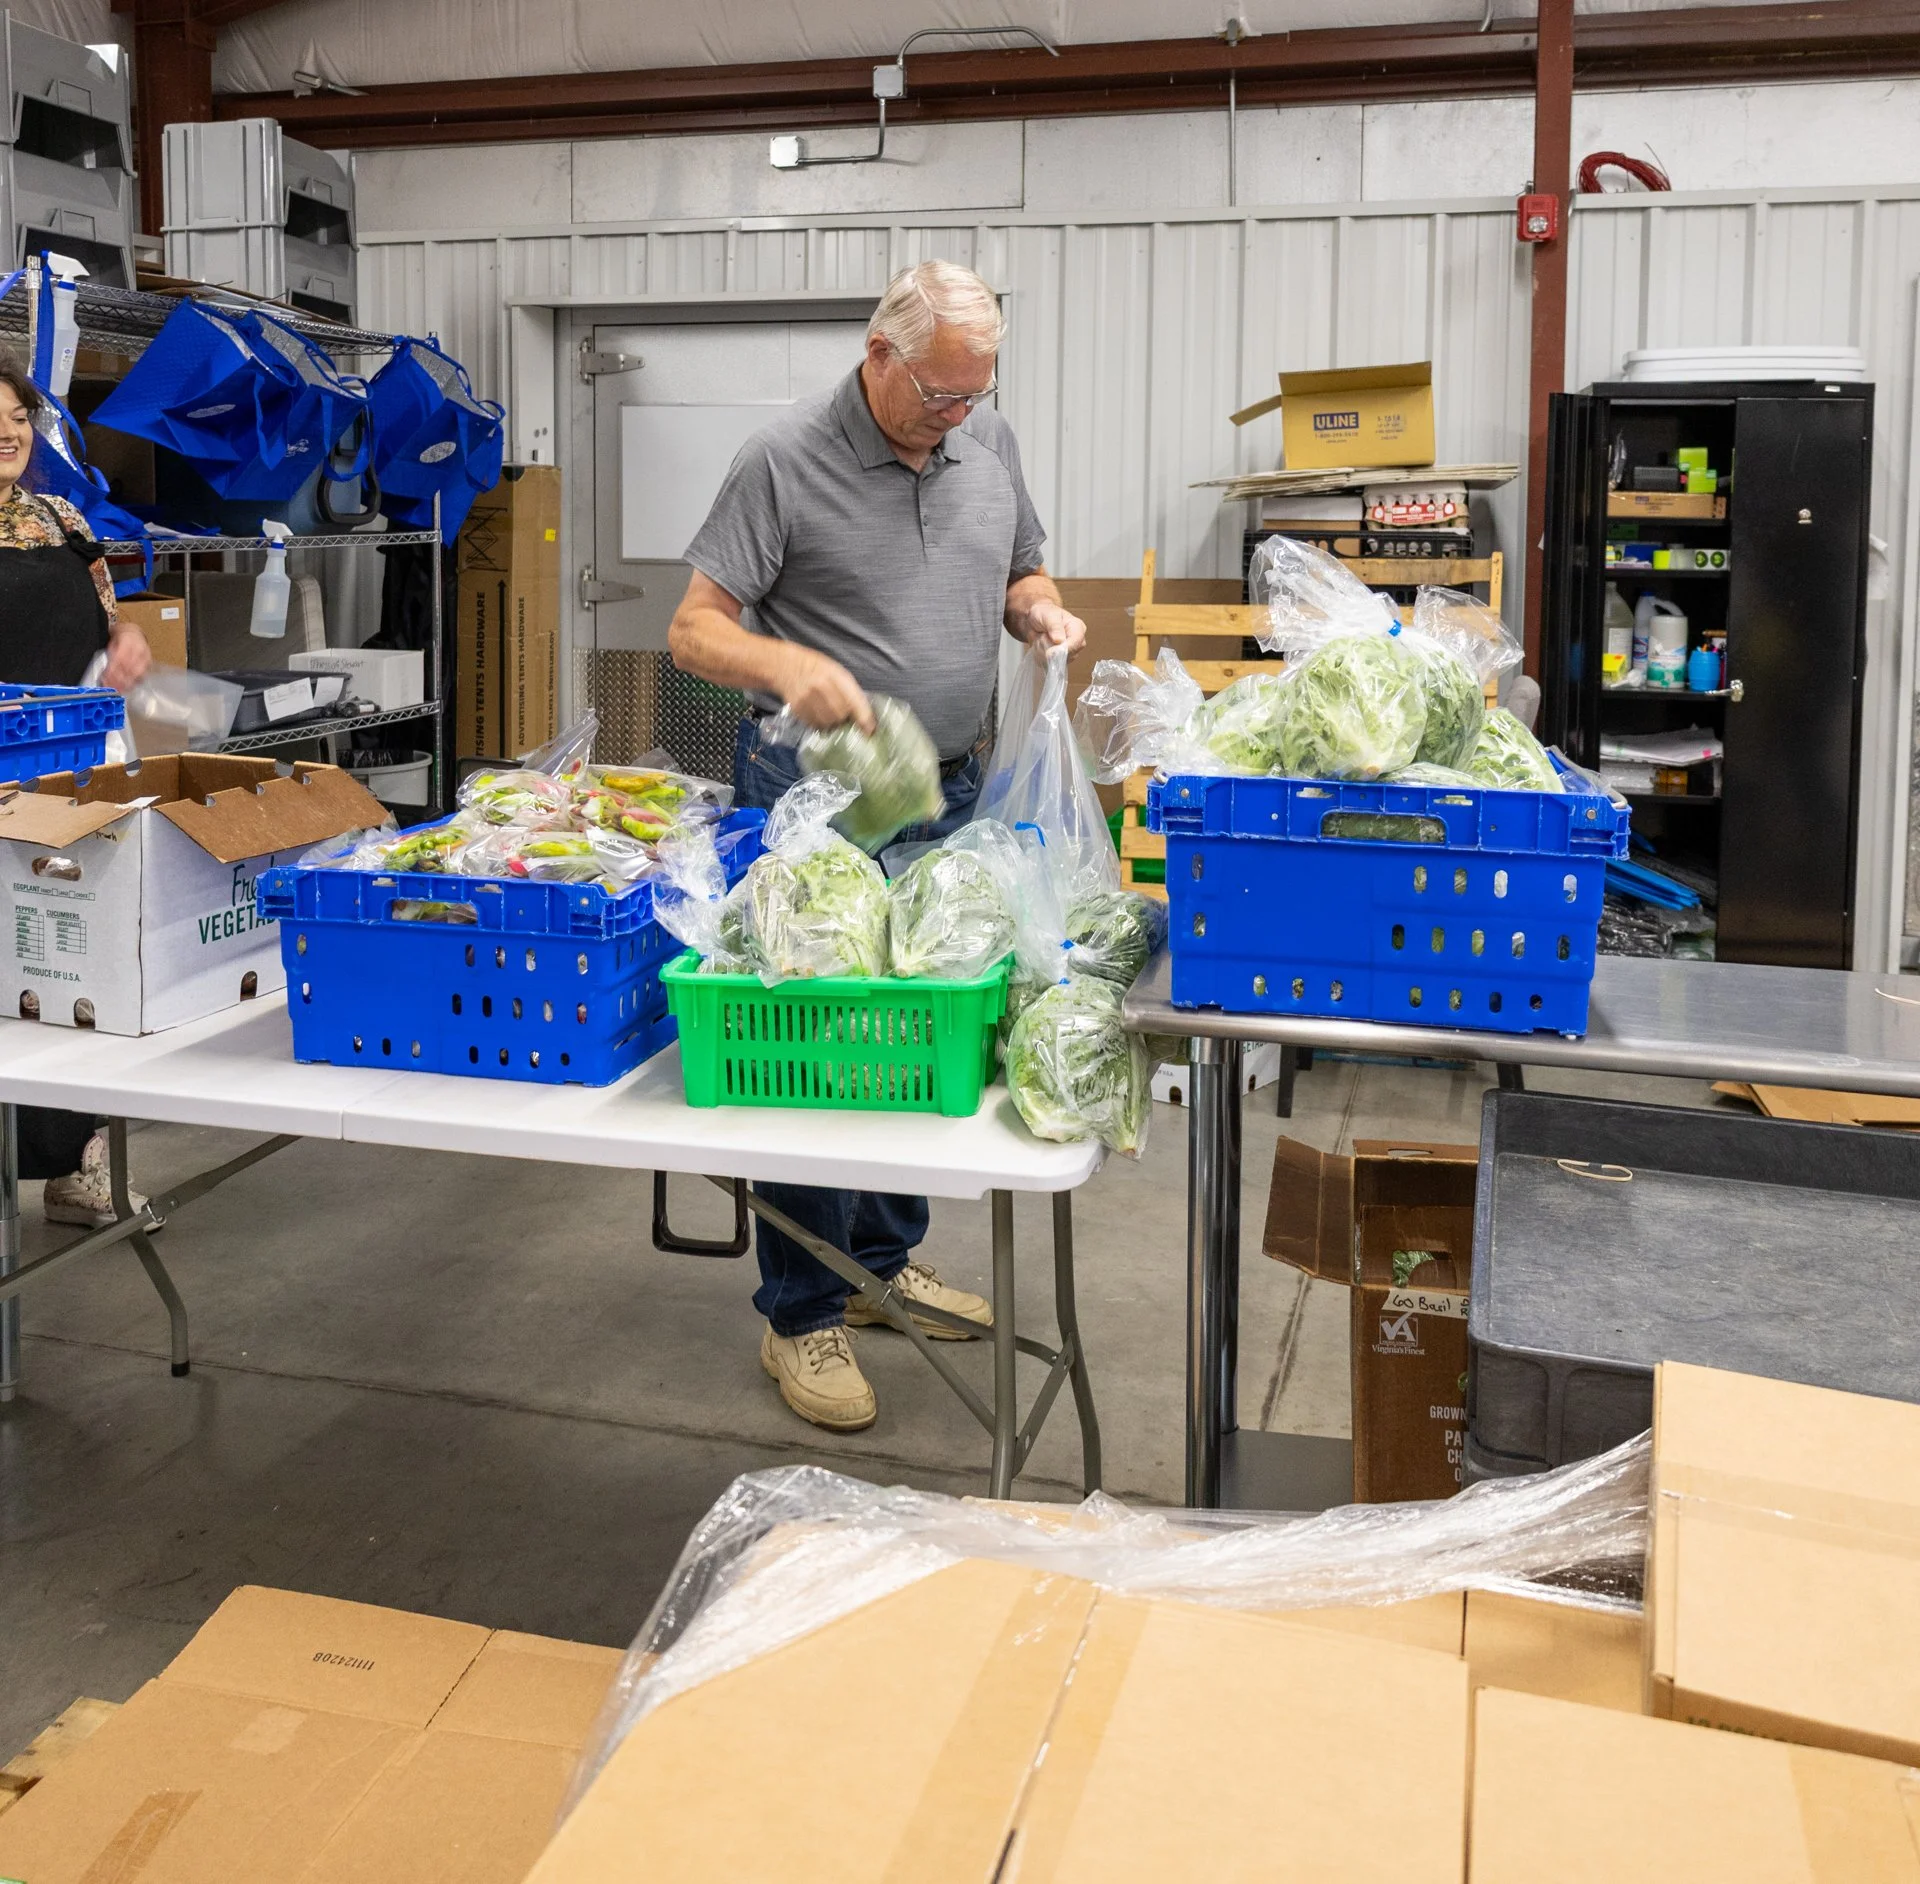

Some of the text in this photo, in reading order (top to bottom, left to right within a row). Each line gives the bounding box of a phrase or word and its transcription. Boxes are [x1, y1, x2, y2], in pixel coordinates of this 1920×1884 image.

[1315, 413, 1358, 430] ULINE
[476, 591, 485, 669] HARDWARE
[476, 673, 485, 711] TENTS
[13, 882, 40, 893] EGGPLANT
[15, 905, 37, 914] PEPPERS
[46, 909, 80, 919] CUCUMBERS
[23, 965, 52, 978] PRODUCE
[53, 971, 62, 979] OF
[1418, 1296, 1451, 1313] Basil
[1371, 1344, 1404, 1355] Virginia's
[1404, 1346, 1425, 1356] Finest
[1429, 1405, 1467, 1420] GROWN
